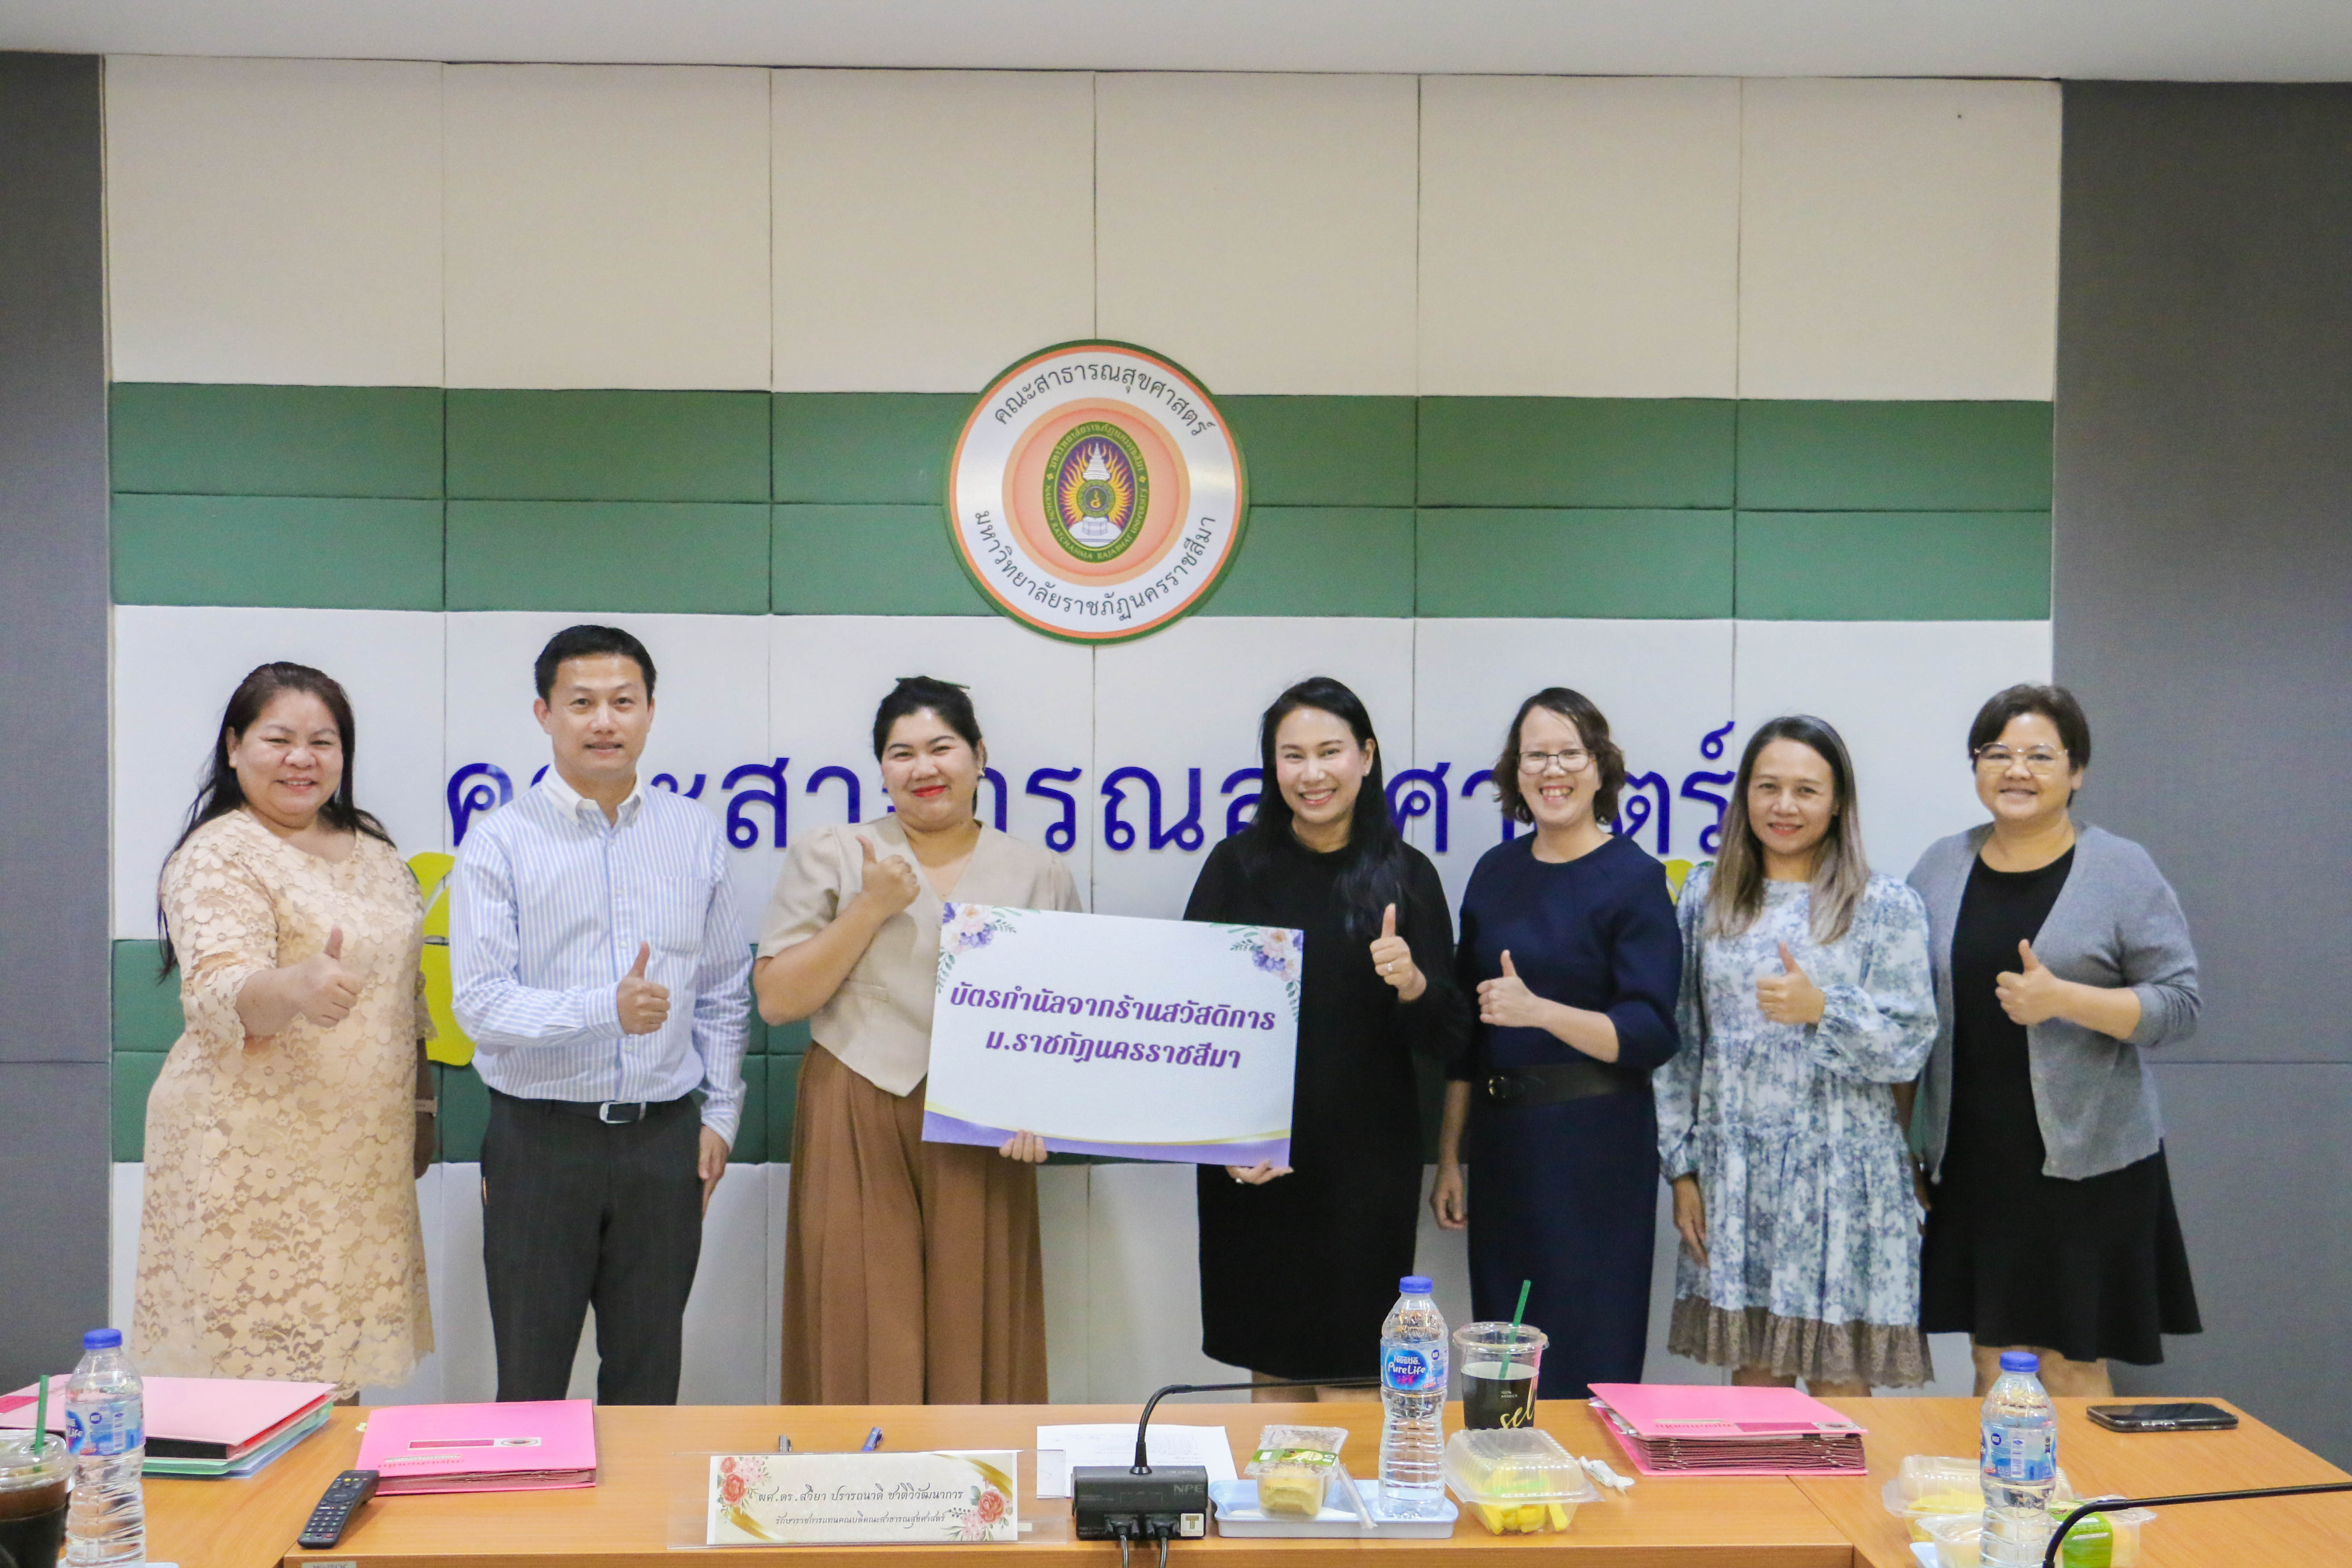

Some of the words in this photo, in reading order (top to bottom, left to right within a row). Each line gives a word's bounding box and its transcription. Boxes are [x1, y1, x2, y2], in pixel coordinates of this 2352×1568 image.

[994, 363, 1216, 436] คณะสาธารณสุขศาสตร์
[975, 510, 1216, 622] มหาวิทยาลัยราชภัฏนครราชสีมา
[950, 981, 1276, 1031] บัตรกำนัลจากร้านสวัสดิการ
[1393, 1356, 1418, 1365] Nestlé
[831, 1483, 884, 1501] ปรารถนาดี
[888, 1482, 963, 1500] ชาติวิวัฒนาการ
[1173, 1484, 1204, 1493] NPE
